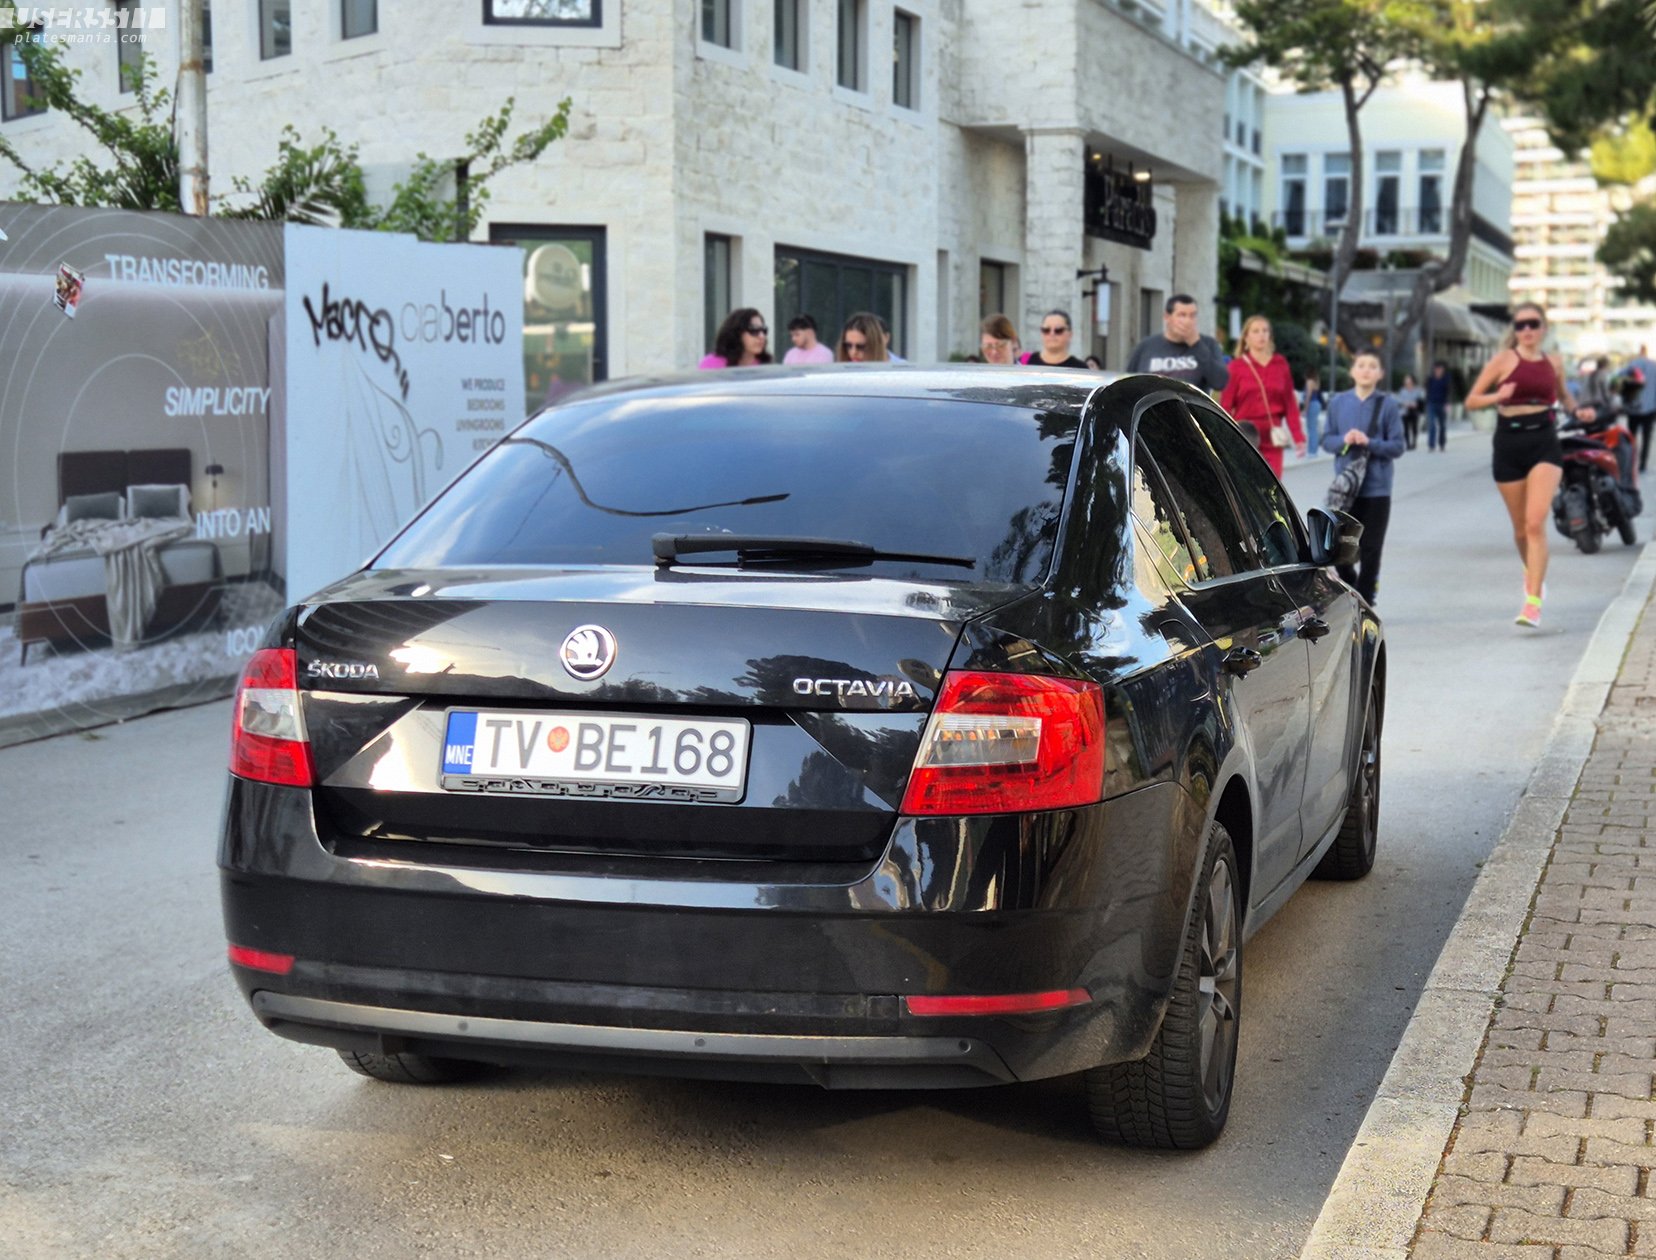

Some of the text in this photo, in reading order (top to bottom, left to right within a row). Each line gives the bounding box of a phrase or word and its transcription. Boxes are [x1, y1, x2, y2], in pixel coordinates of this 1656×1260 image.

[105, 253, 269, 290] TRANSFORMING
[1150, 355, 1198, 372] BOSS
[164, 386, 271, 417] SIMPLICITY
[196, 507, 271, 539] INTO AN
[307, 659, 380, 680] ŠKODA
[792, 678, 914, 698] OCTAVIA
[444, 744, 474, 765] MNE
[486, 719, 542, 769] TV
